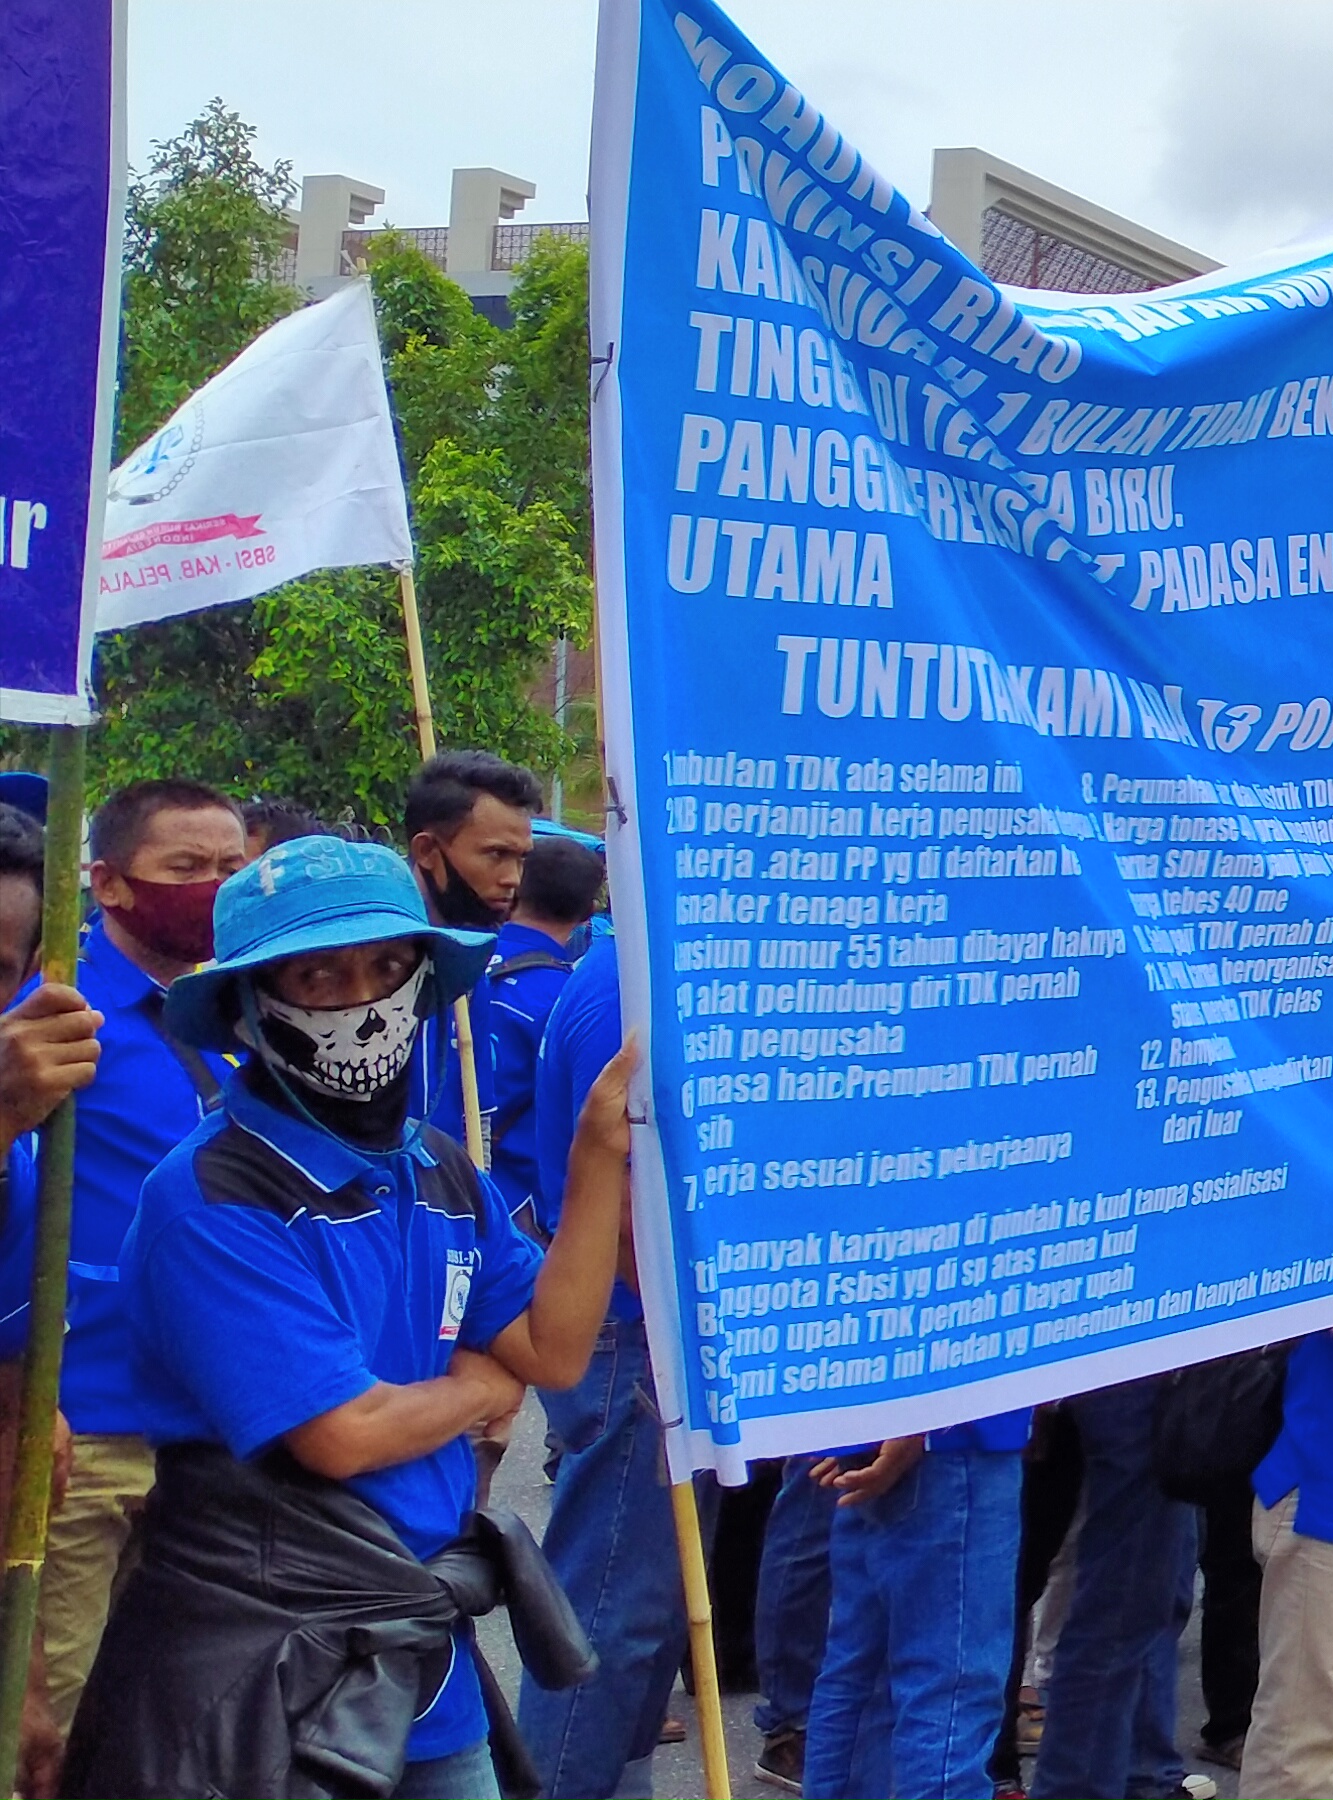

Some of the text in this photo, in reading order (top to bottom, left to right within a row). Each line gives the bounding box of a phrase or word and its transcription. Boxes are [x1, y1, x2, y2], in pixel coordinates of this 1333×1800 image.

[1017, 397, 1182, 457] BULAN
[1084, 464, 1185, 537] BIRU.
[666, 513, 895, 609] UTAMA
[1130, 537, 1282, 613] PADASA
[785, 753, 1023, 794] TDK ada selama ini
[703, 798, 864, 840] perjanjian
[870, 803, 933, 841] kerja
[845, 845, 877, 881] PP
[881, 850, 912, 884] yg
[917, 845, 943, 881] di
[946, 843, 1057, 879] daftarkan
[776, 888, 949, 931] tenaga kerja
[1222, 883, 1290, 914] 40 me
[757, 938, 843, 970] umur
[846, 932, 884, 970] 55
[888, 933, 958, 969] tahun
[962, 928, 1048, 966] dibayar
[1051, 925, 1127, 961] haknya
[1197, 919, 1239, 952] TDK
[1236, 917, 1314, 953] pernah
[695, 977, 751, 1017] alat
[754, 976, 901, 1018] pelindung
[910, 973, 952, 1010] diri
[956, 971, 999, 1006] TDK
[1001, 965, 1081, 1006] pernah
[1238, 986, 1323, 1020] TDK jelas
[739, 1019, 906, 1062] pengusaha
[697, 1043, 1098, 1108] masa Prempuan TDK pernah
[1134, 1076, 1160, 1111] 13.
[1162, 1107, 1243, 1145] dari luar
[762, 1151, 865, 1191] sesuai
[867, 1145, 935, 1188] jenis
[716, 1160, 1290, 1274] banyak kariyawan di pindah ke kud tanpa sosialisasi
[825, 1222, 1138, 1307] Fsbsi yg di sp atas nama kud
[781, 1356, 888, 1396] selama
[892, 1345, 926, 1382] ini
[928, 1330, 1002, 1371] Medan
[1004, 1325, 1031, 1359] yg
[1032, 1296, 1156, 1350] menentukan
[1156, 1287, 1193, 1322] dan
[1196, 1272, 1259, 1313] banyak
[1259, 1259, 1304, 1297] hasil
[786, 1261, 1136, 1354] upah TDK pernah di bayar upah
